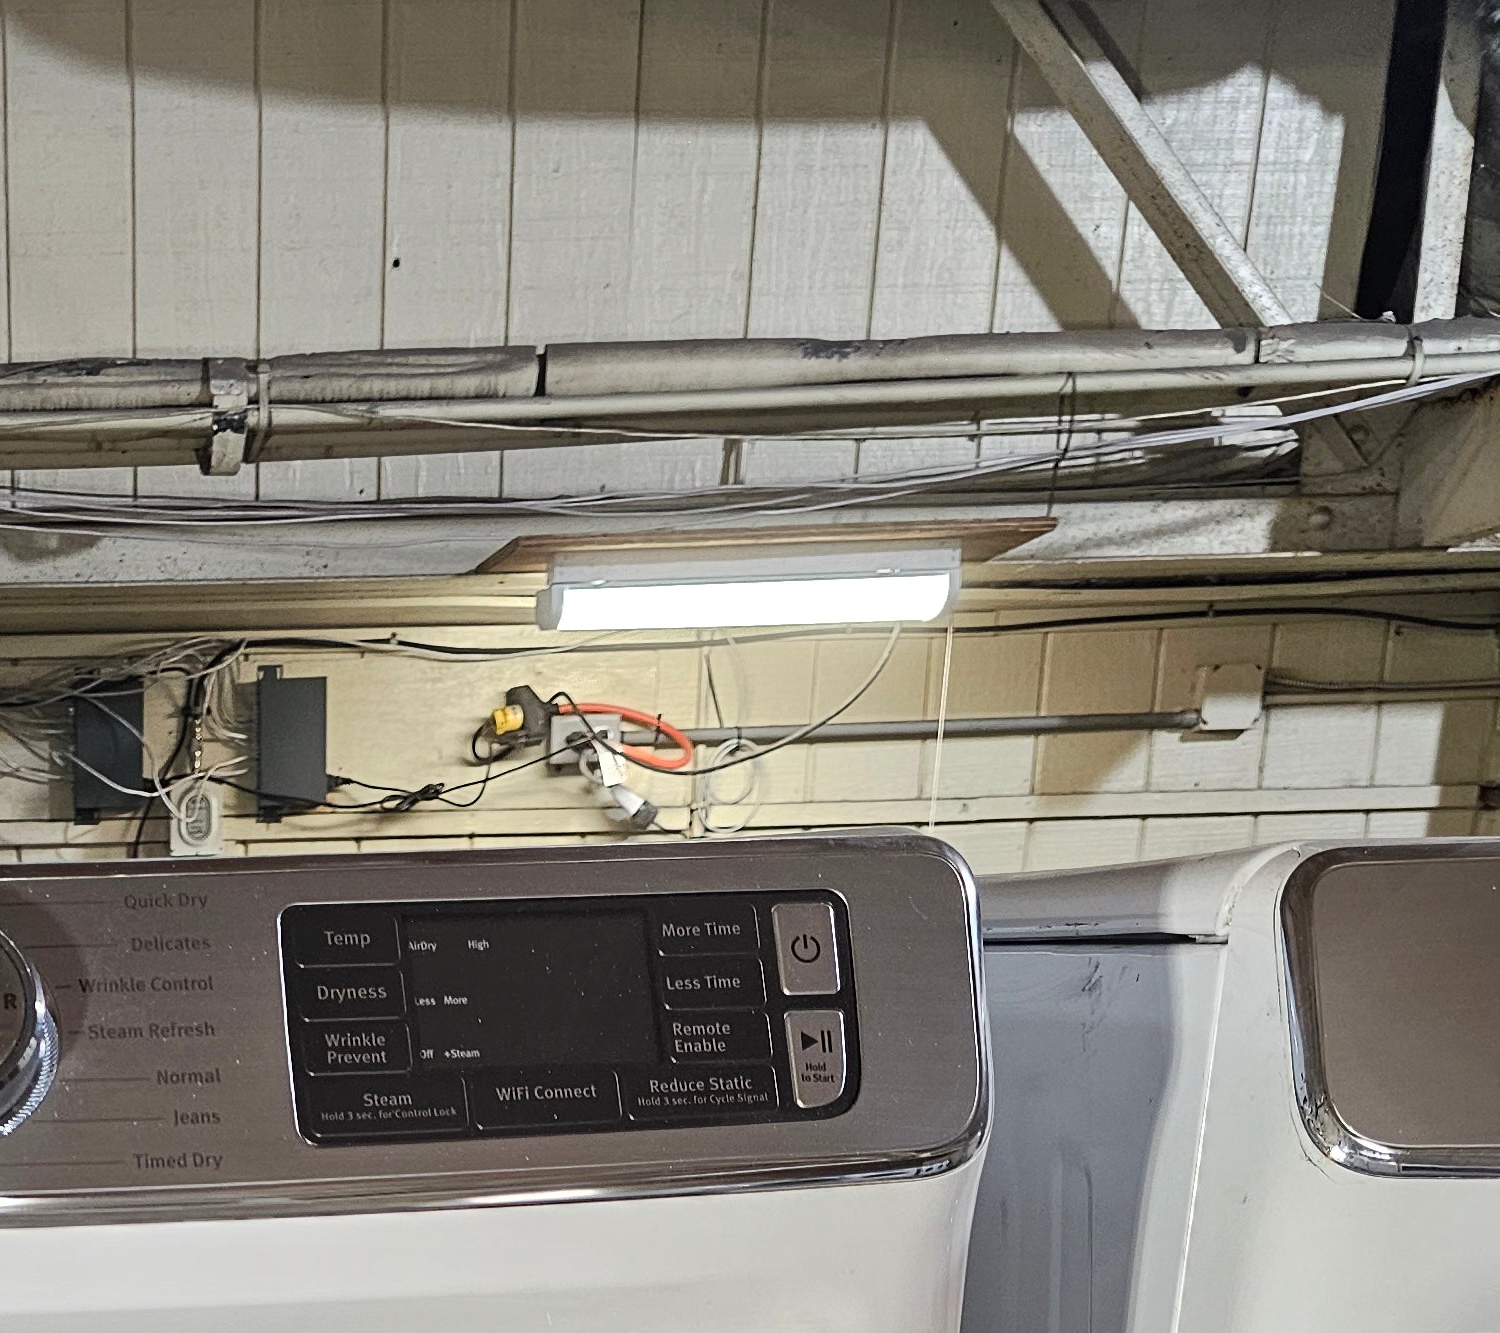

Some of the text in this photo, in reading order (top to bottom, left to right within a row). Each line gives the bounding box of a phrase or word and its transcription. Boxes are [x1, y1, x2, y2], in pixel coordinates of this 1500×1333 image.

[124, 892, 208, 910] Quick Dry
[662, 922, 741, 937] More Time
[131, 936, 211, 952] Delicates
[323, 930, 371, 948] Temp
[467, 939, 490, 951] High
[78, 974, 214, 994] Wrinkle Control
[666, 975, 741, 990] Less Time
[317, 985, 387, 1003] Dryness
[443, 995, 468, 1005] More
[88, 1021, 216, 1040] Steam Refresh
[673, 1022, 730, 1036] Remote
[325, 1032, 386, 1047] Wrinkle
[675, 1039, 727, 1053] Enable
[327, 1049, 387, 1064] Prevent
[805, 1062, 827, 1072] Hold
[156, 1067, 221, 1086] Normal
[650, 1075, 753, 1093] Reduce Static
[801, 1073, 835, 1083] to Start
[363, 1092, 412, 1107] Steam
[496, 1084, 597, 1101] WiFi Connect
[638, 1092, 769, 1107] Hold 3 sec. for Cycle Signal
[173, 1108, 221, 1127] Jeans
[321, 1106, 457, 1121] Hold 3 sec. for Control Lock
[133, 1151, 223, 1170] Timed Dry
